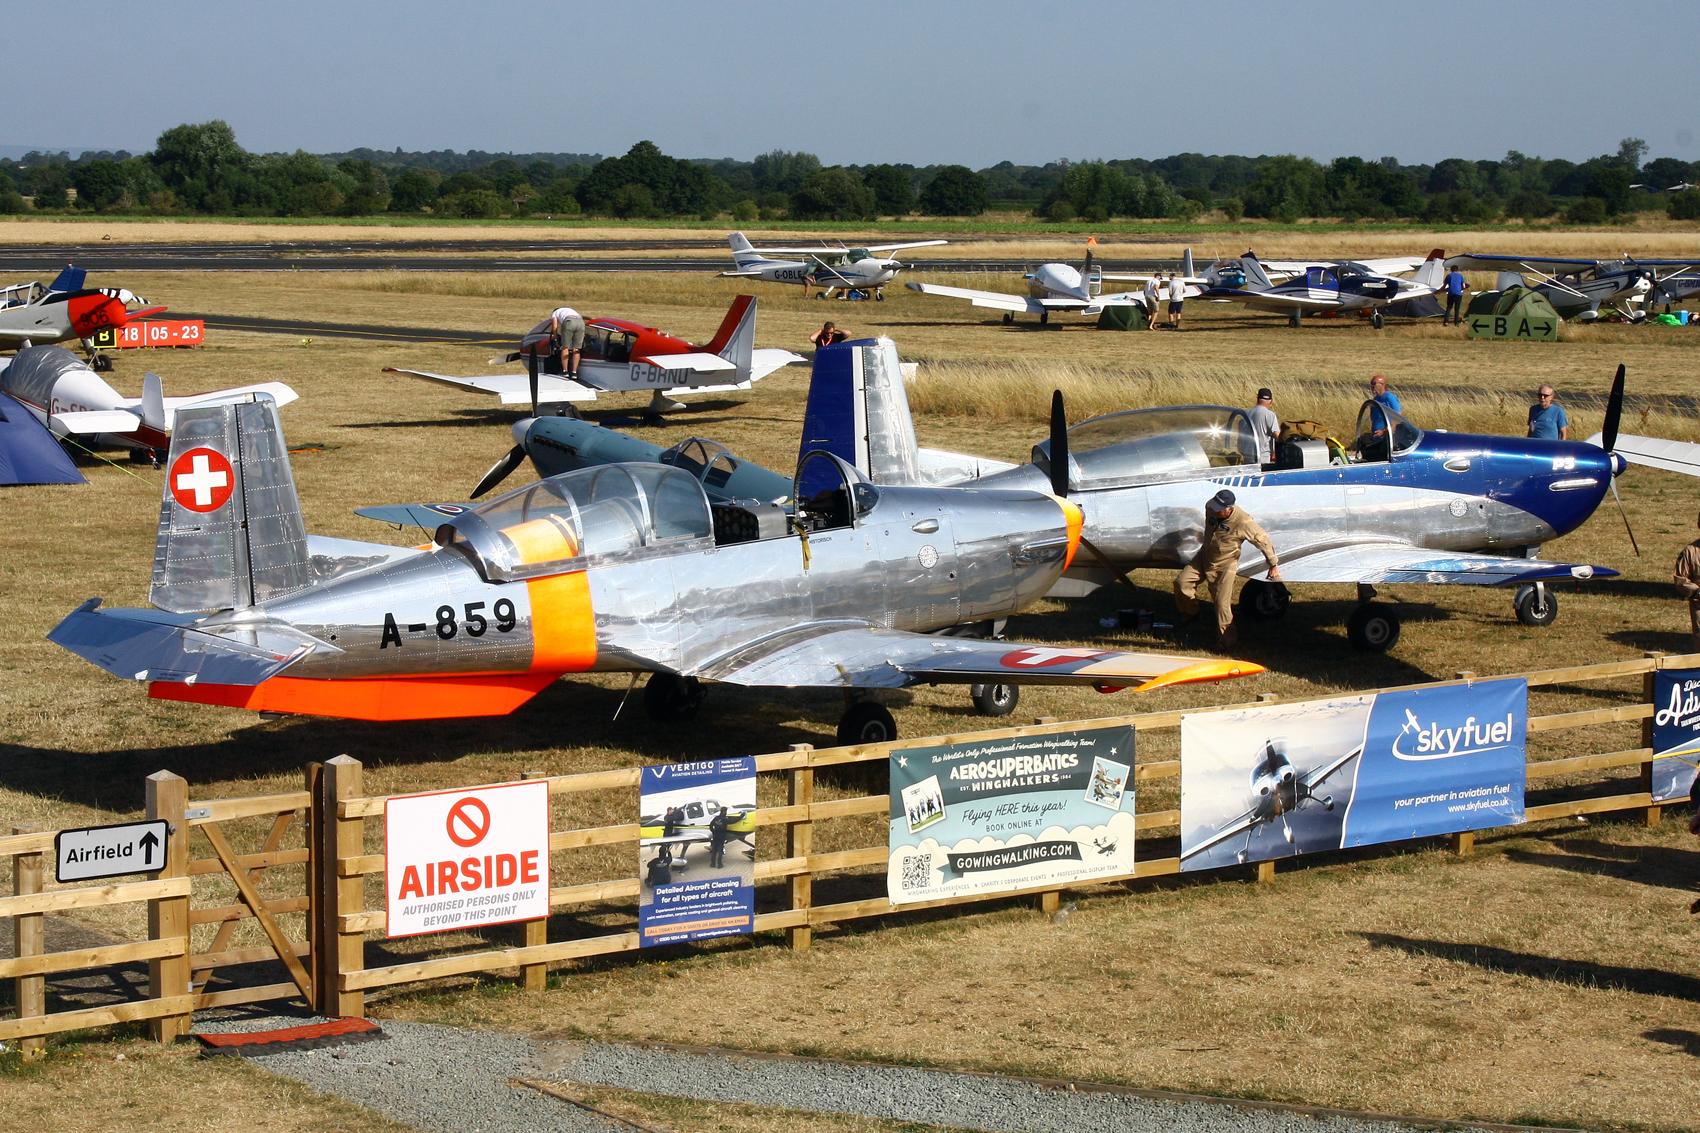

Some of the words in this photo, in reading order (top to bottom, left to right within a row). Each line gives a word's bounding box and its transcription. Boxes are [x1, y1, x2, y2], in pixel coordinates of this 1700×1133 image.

[123, 328, 139, 341] 18
[151, 327, 168, 340] 05
[181, 325, 199, 339] 23
[1494, 317, 1507, 336] B
[1517, 318, 1531, 337] A
[380, 598, 517, 649] A-859
[1416, 713, 1513, 754] skyfuel
[931, 755, 942, 763] The
[965, 749, 980, 759] Only
[980, 744, 1016, 757] Professional
[1015, 742, 1042, 751] Formation
[1043, 740, 1079, 750] Wingwalking
[1079, 739, 1096, 747] Team!
[670, 761, 714, 772] VERTIGO
[950, 753, 1079, 780] AEROSUPERBATICS
[972, 774, 1059, 792] WINGWALKERS
[1394, 798, 1416, 810] your
[1415, 791, 1449, 807] partner
[1450, 790, 1458, 800] in
[1458, 787, 1492, 799] aviation
[1493, 784, 1511, 795] fuel
[1448, 797, 1510, 813] www.skyfuel.co.uk
[962, 808, 993, 826] Flying
[995, 801, 1019, 816] HERE
[1021, 802, 1039, 813] this
[1041, 800, 1067, 817] year!
[986, 823, 1006, 833] BOOK
[1008, 820, 1032, 830] ONLINE
[1034, 818, 1044, 826] AT
[66, 842, 133, 864] Airfield
[956, 844, 1073, 869] GOWINGWALKING.COM
[398, 850, 540, 900] AIRSIDE
[1030, 874, 1047, 882] EVENTS
[656, 886, 684, 895] Detailed
[684, 883, 711, 892] Aircraft
[711, 880, 740, 889] Cleaning
[681, 893, 700, 902] types
[701, 891, 708, 899] of
[709, 889, 733, 898] aircraft
[402, 899, 464, 916] AUTHORISED
[466, 893, 510, 908] PERSONS
[512, 889, 537, 901] ONLY
[423, 912, 462, 927] BEYOND
[464, 909, 486, 922] THIS
[488, 905, 518, 918] POINT
